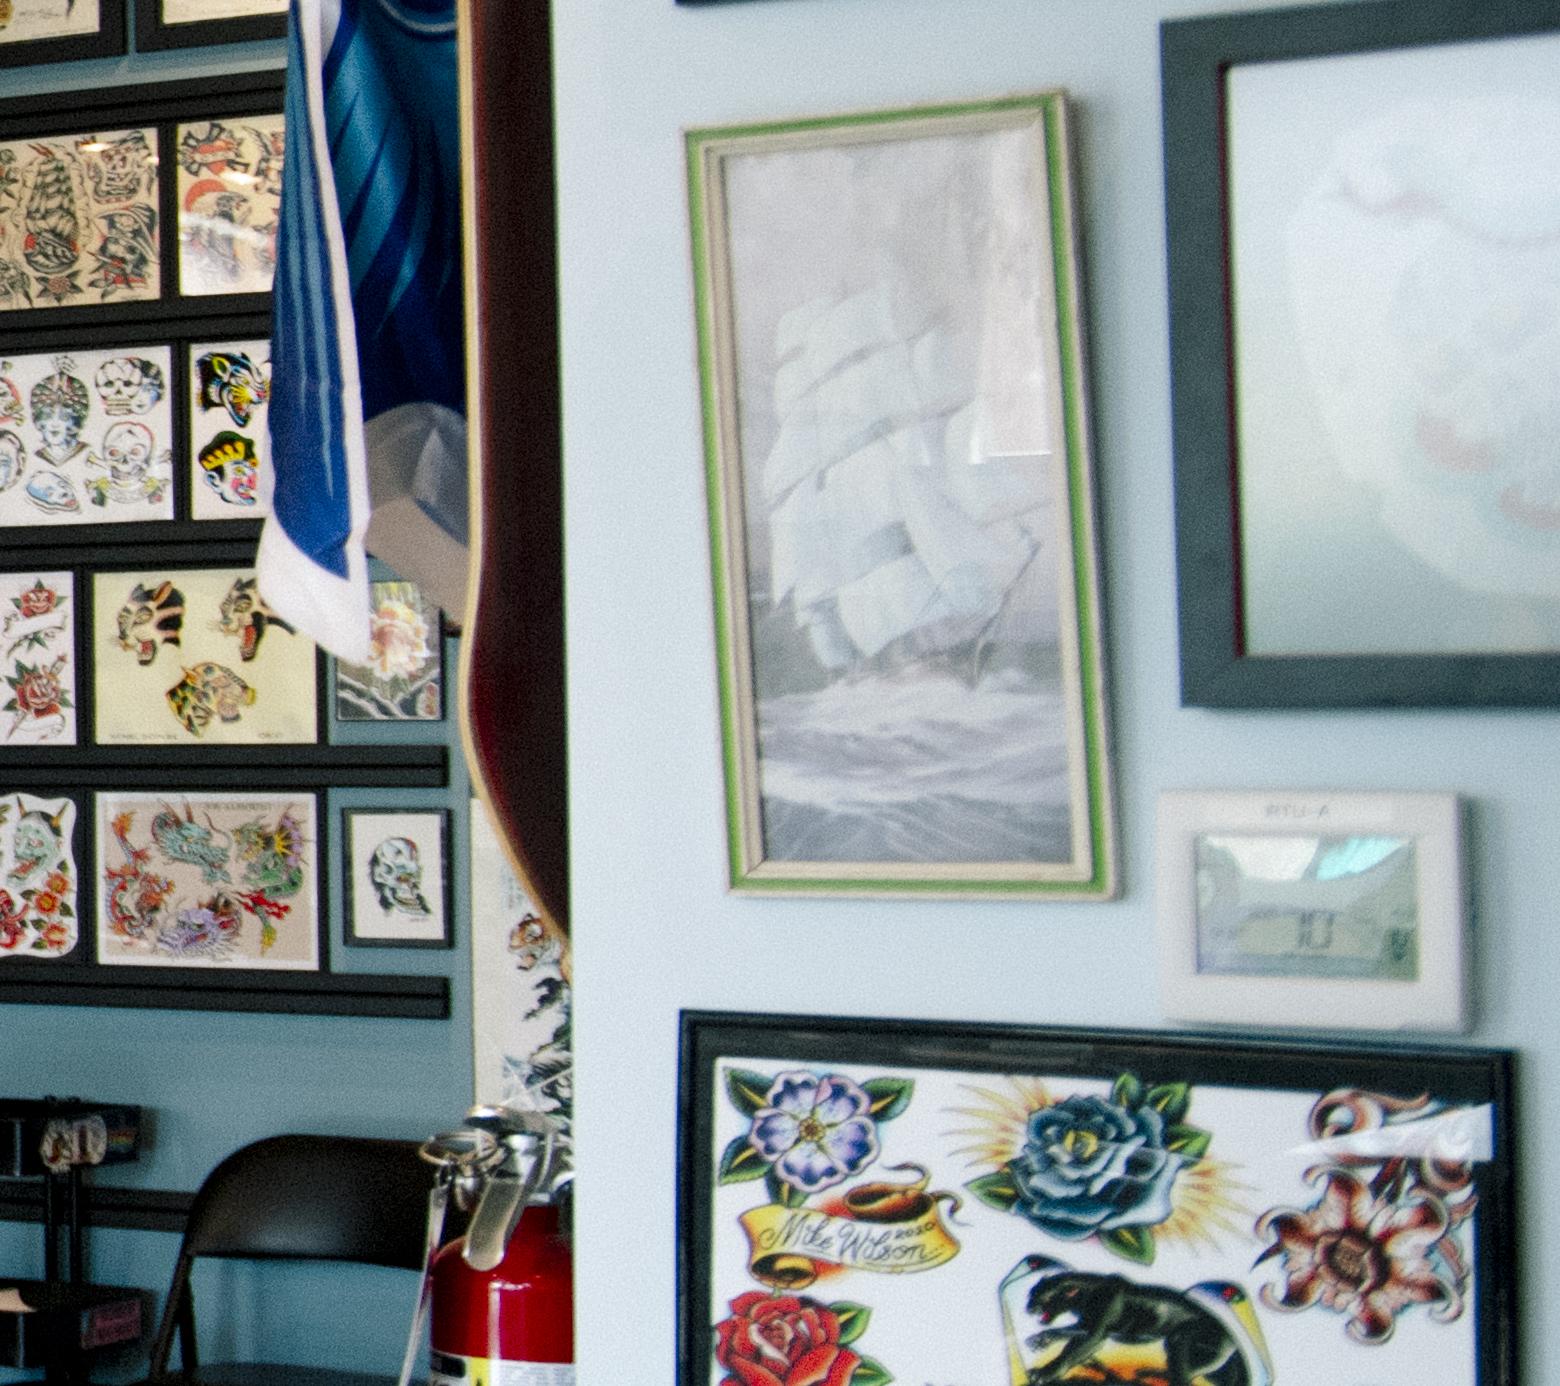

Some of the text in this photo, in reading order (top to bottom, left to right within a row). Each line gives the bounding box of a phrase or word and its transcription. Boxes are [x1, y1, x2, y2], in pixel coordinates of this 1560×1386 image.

[759, 1213, 932, 1262] Mike Wilson
[894, 1221, 936, 1240] 2020
